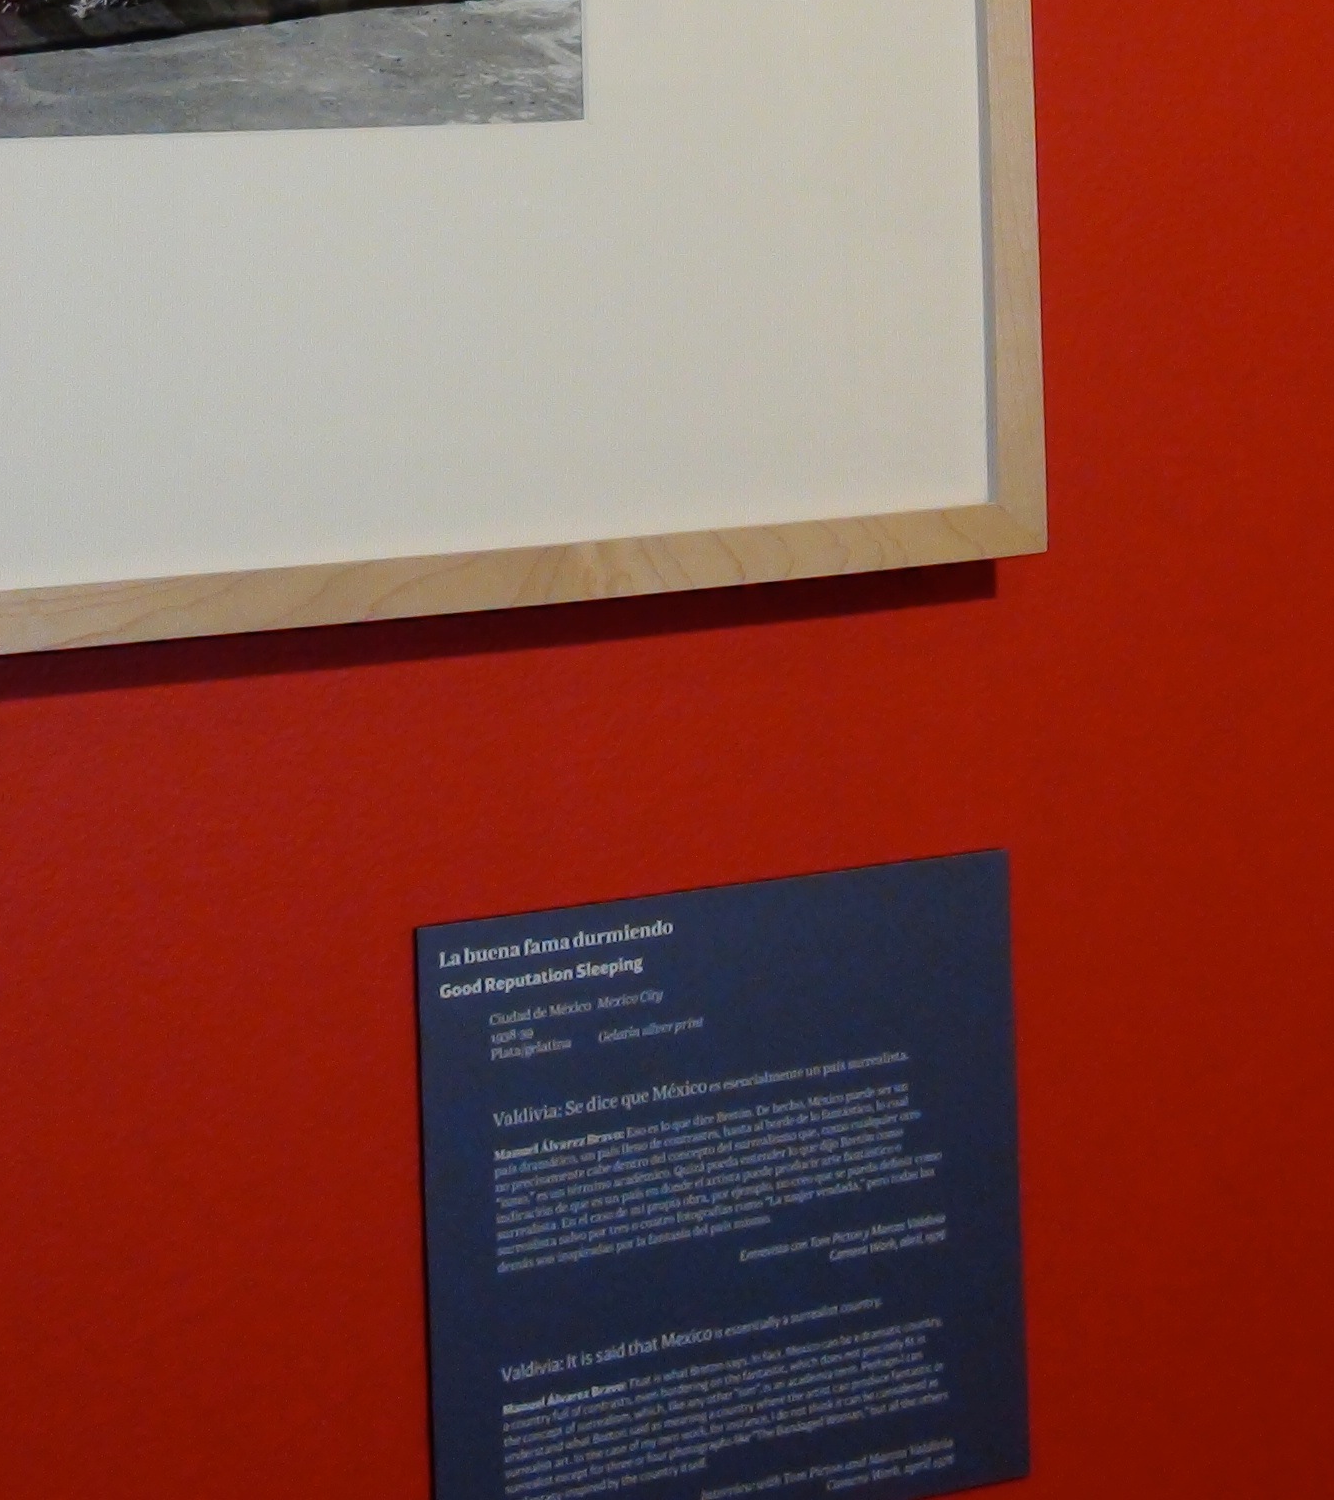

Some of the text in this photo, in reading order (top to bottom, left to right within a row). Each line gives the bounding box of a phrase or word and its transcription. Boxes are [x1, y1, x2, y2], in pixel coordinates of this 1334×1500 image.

[439, 920, 673, 969] La buena fama durmiendo
[440, 958, 643, 999] Good Reputation Sleeping
[493, 1105, 562, 1127] Valdivia:
[565, 1100, 583, 1116] Se
[586, 1095, 618, 1112] dice
[621, 1091, 649, 1110] que
[652, 1081, 707, 1101] México
